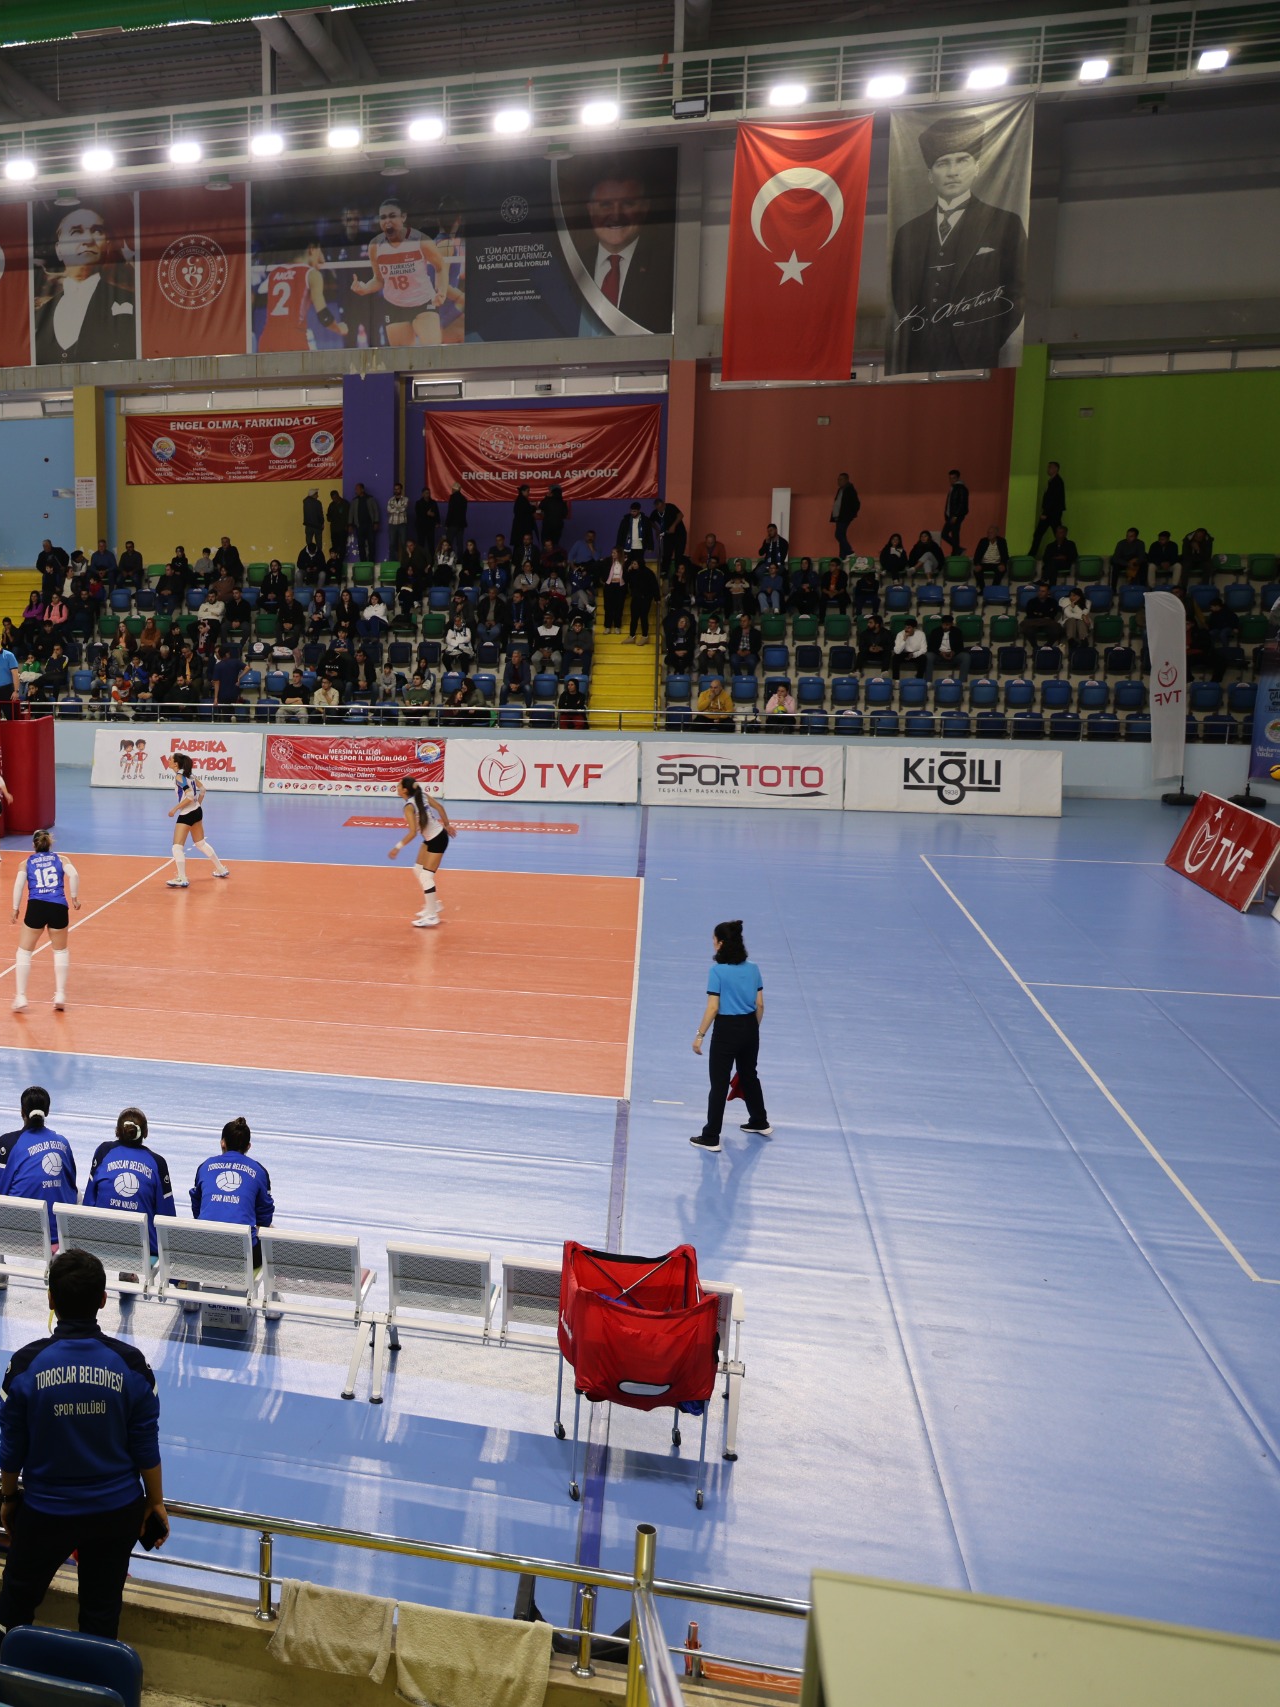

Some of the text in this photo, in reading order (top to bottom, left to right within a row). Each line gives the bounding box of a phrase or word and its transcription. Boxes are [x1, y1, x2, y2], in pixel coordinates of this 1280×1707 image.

[485, 244, 544, 255] TÜM ANTRENÖR
[487, 251, 553, 262] SPORCULARIMIZA
[389, 262, 415, 270] TURKISH
[478, 260, 550, 270] BAŞARILAR DİLİYORUM
[389, 268, 416, 276] AIRLINES
[389, 275, 410, 290] 18
[271, 281, 291, 316] 2
[170, 416, 318, 431] ENGEL OLMA, FARKINDA OL
[517, 433, 547, 441] Mersin
[517, 442, 550, 451] Gençlik
[566, 442, 586, 451] Spor
[525, 451, 574, 460] Müdürlüğü
[461, 468, 620, 480] ENGELLERİ SPORLA AŞIYORUZ
[302, 753, 330, 761] GENÇLİK
[365, 754, 408, 762] MÜDÜRLÜĞÜ
[354, 748, 381, 756] VALİLİĞİ
[160, 755, 236, 772] VEYBOL
[158, 773, 176, 781] Türkiy
[204, 775, 239, 783] Federasyonu
[534, 763, 604, 788] TVF
[656, 763, 824, 788] SPORTOTO
[1210, 837, 1254, 882] TVF
[34, 866, 59, 888] 16
[28, 1141, 50, 1157] TOROSLAR
[107, 1160, 153, 1179] TOROSLAR BELEDİYESİ
[207, 1162, 257, 1179] TOROSLAR BELEDİYESİ
[42, 1180, 53, 1189] SPOR
[110, 1198, 139, 1210] SPOR KULÜBÜ
[210, 1194, 240, 1204] SPOR KULÜBÜ
[36, 1365, 124, 1393] TOROSLAR BELEDİYESİ
[53, 1400, 106, 1417] SPOR KULÜBÜ
